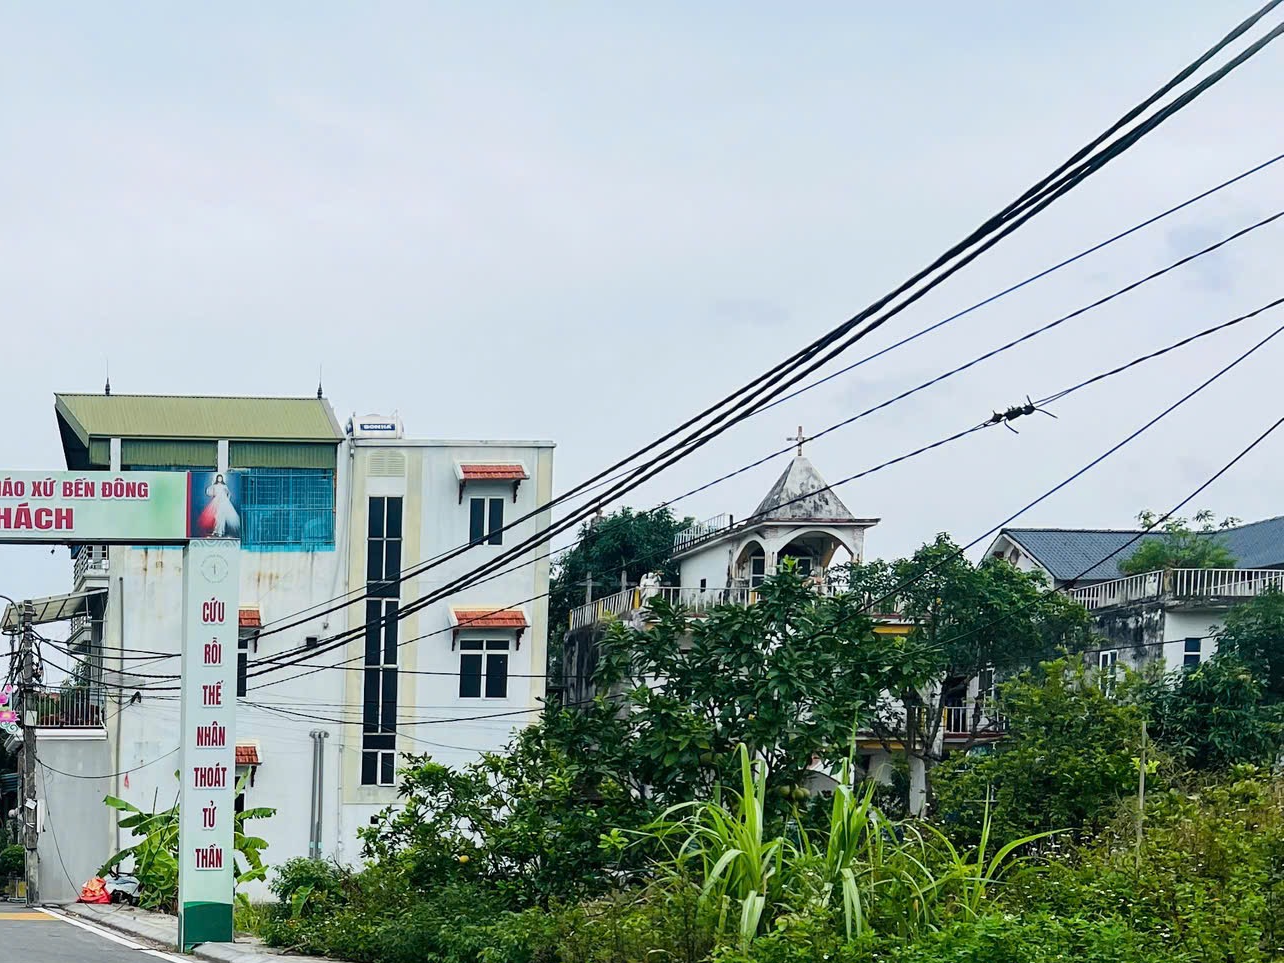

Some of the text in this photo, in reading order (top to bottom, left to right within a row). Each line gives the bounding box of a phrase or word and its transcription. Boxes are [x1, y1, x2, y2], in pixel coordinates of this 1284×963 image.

[31, 478, 56, 497] XỨ
[62, 478, 95, 497] BẾN
[101, 478, 148, 498] ĐÔNG
[202, 597, 225, 623] CỨU
[204, 636, 222, 664] RỖI
[202, 680, 224, 705] THẾ
[196, 720, 226, 746] NHÂN
[194, 762, 228, 788] THOÁT
[202, 800, 217, 828] TỬ
[195, 843, 223, 868] THẦN
